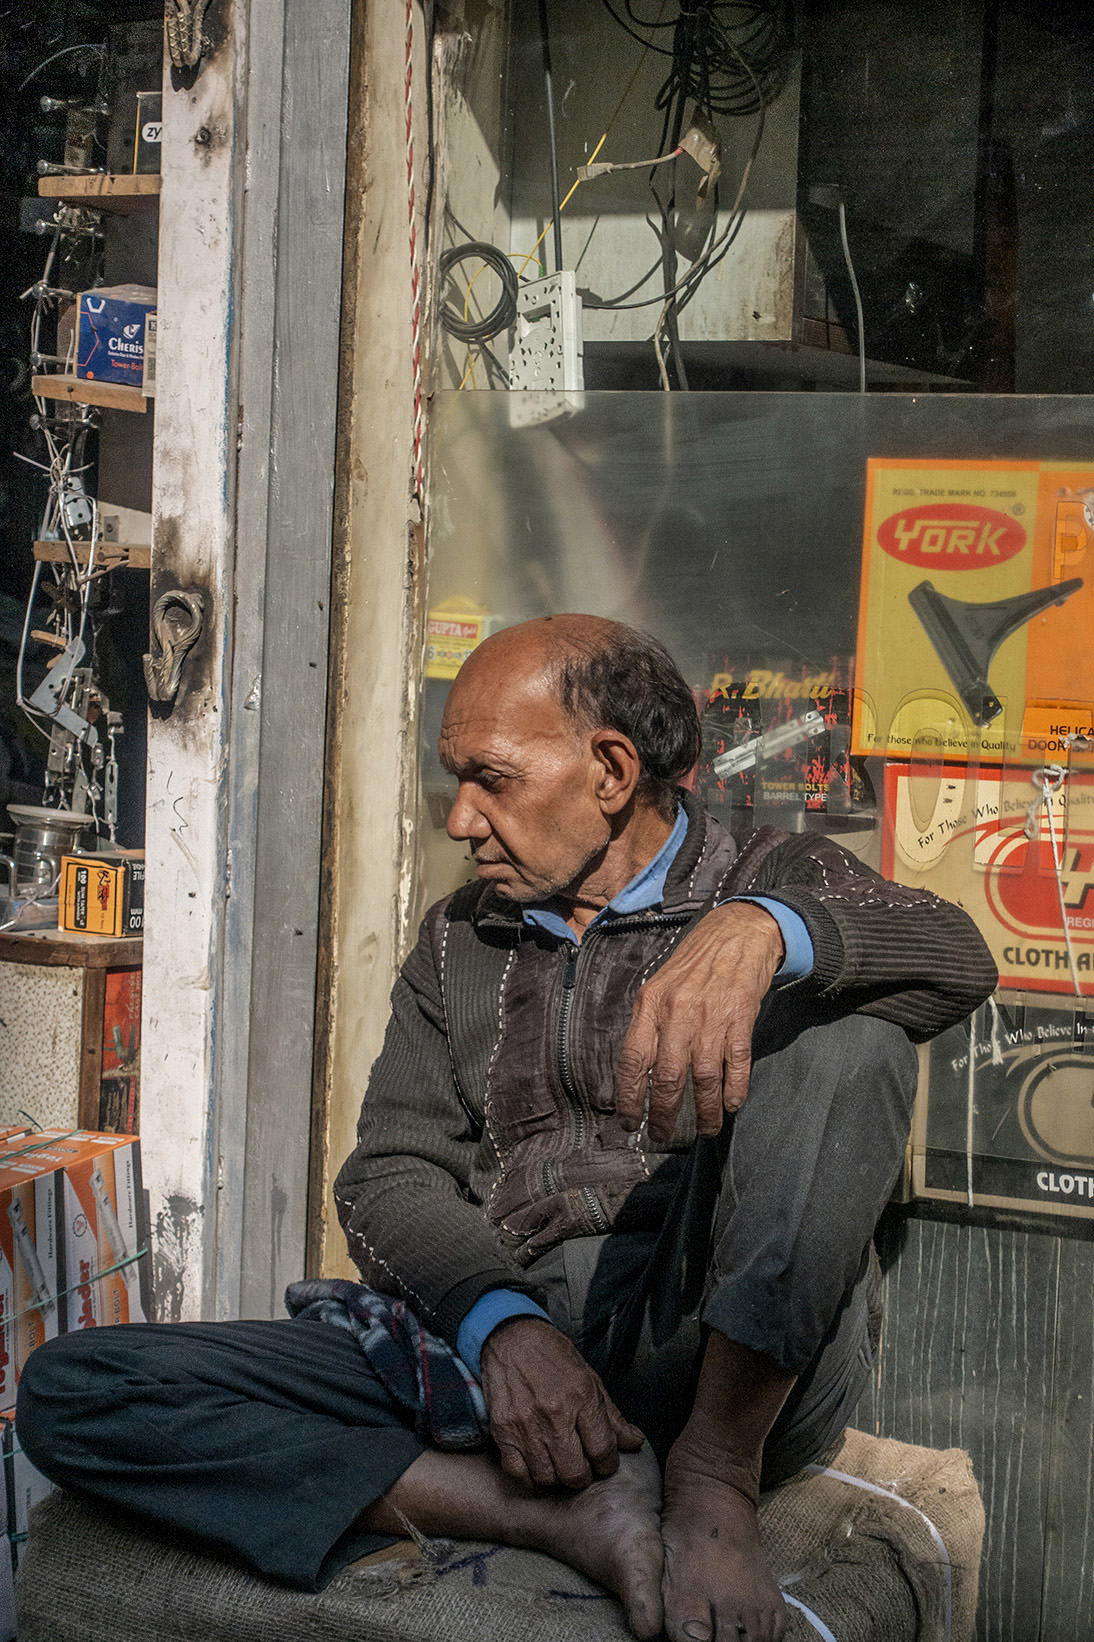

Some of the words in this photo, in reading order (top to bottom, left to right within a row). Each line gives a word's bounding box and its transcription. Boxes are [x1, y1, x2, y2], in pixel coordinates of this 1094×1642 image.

[111, 359, 129, 368] Tower
[919, 488, 946, 497] TRADE
[947, 489, 971, 497] MARK
[894, 519, 1008, 555] YORK
[867, 734, 883, 742] For
[886, 735, 912, 745] those
[914, 736, 934, 746] who
[935, 737, 968, 748] believe
[981, 740, 1016, 751] Quality
[761, 781, 796, 790] TOWER
[798, 783, 829, 791] BOLTS
[763, 792, 801, 801] BARREL
[804, 793, 827, 801] TYPE
[917, 831, 934, 849] For
[938, 815, 968, 835] Those
[972, 804, 999, 819] Who
[1065, 916, 1094, 928] REG
[1003, 947, 1069, 970] CLOTH
[1077, 952, 1094, 971] A
[952, 1055, 968, 1071] For
[1005, 1029, 1033, 1045] Who
[1037, 1023, 1071, 1039] Believe
